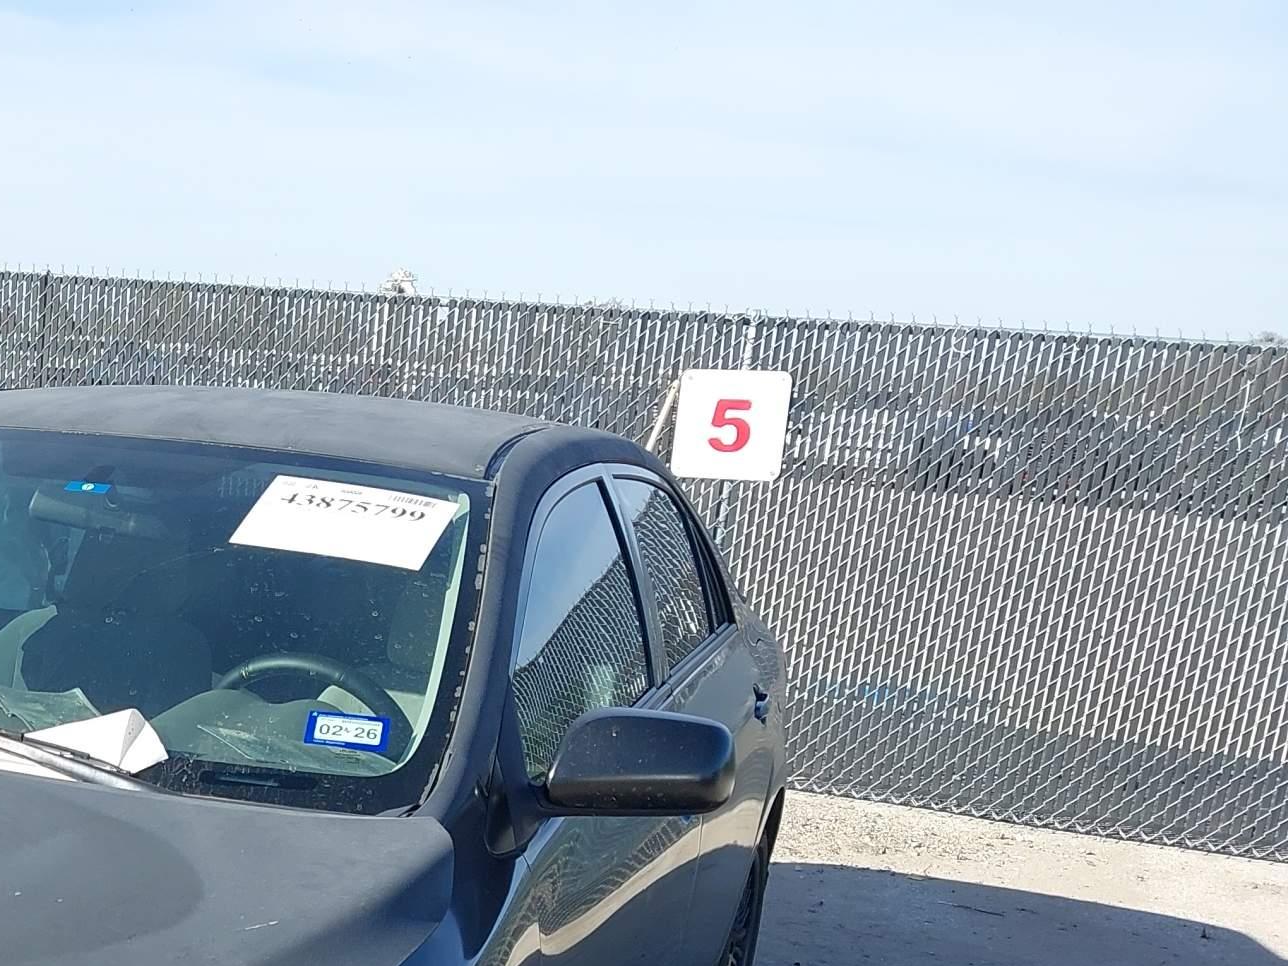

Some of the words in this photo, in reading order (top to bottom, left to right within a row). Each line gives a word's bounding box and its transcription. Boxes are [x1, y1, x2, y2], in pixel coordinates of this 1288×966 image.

[707, 399, 752, 452] 5
[280, 491, 426, 522] 43875799
[319, 723, 343, 737] 02
[354, 727, 378, 740] 26
